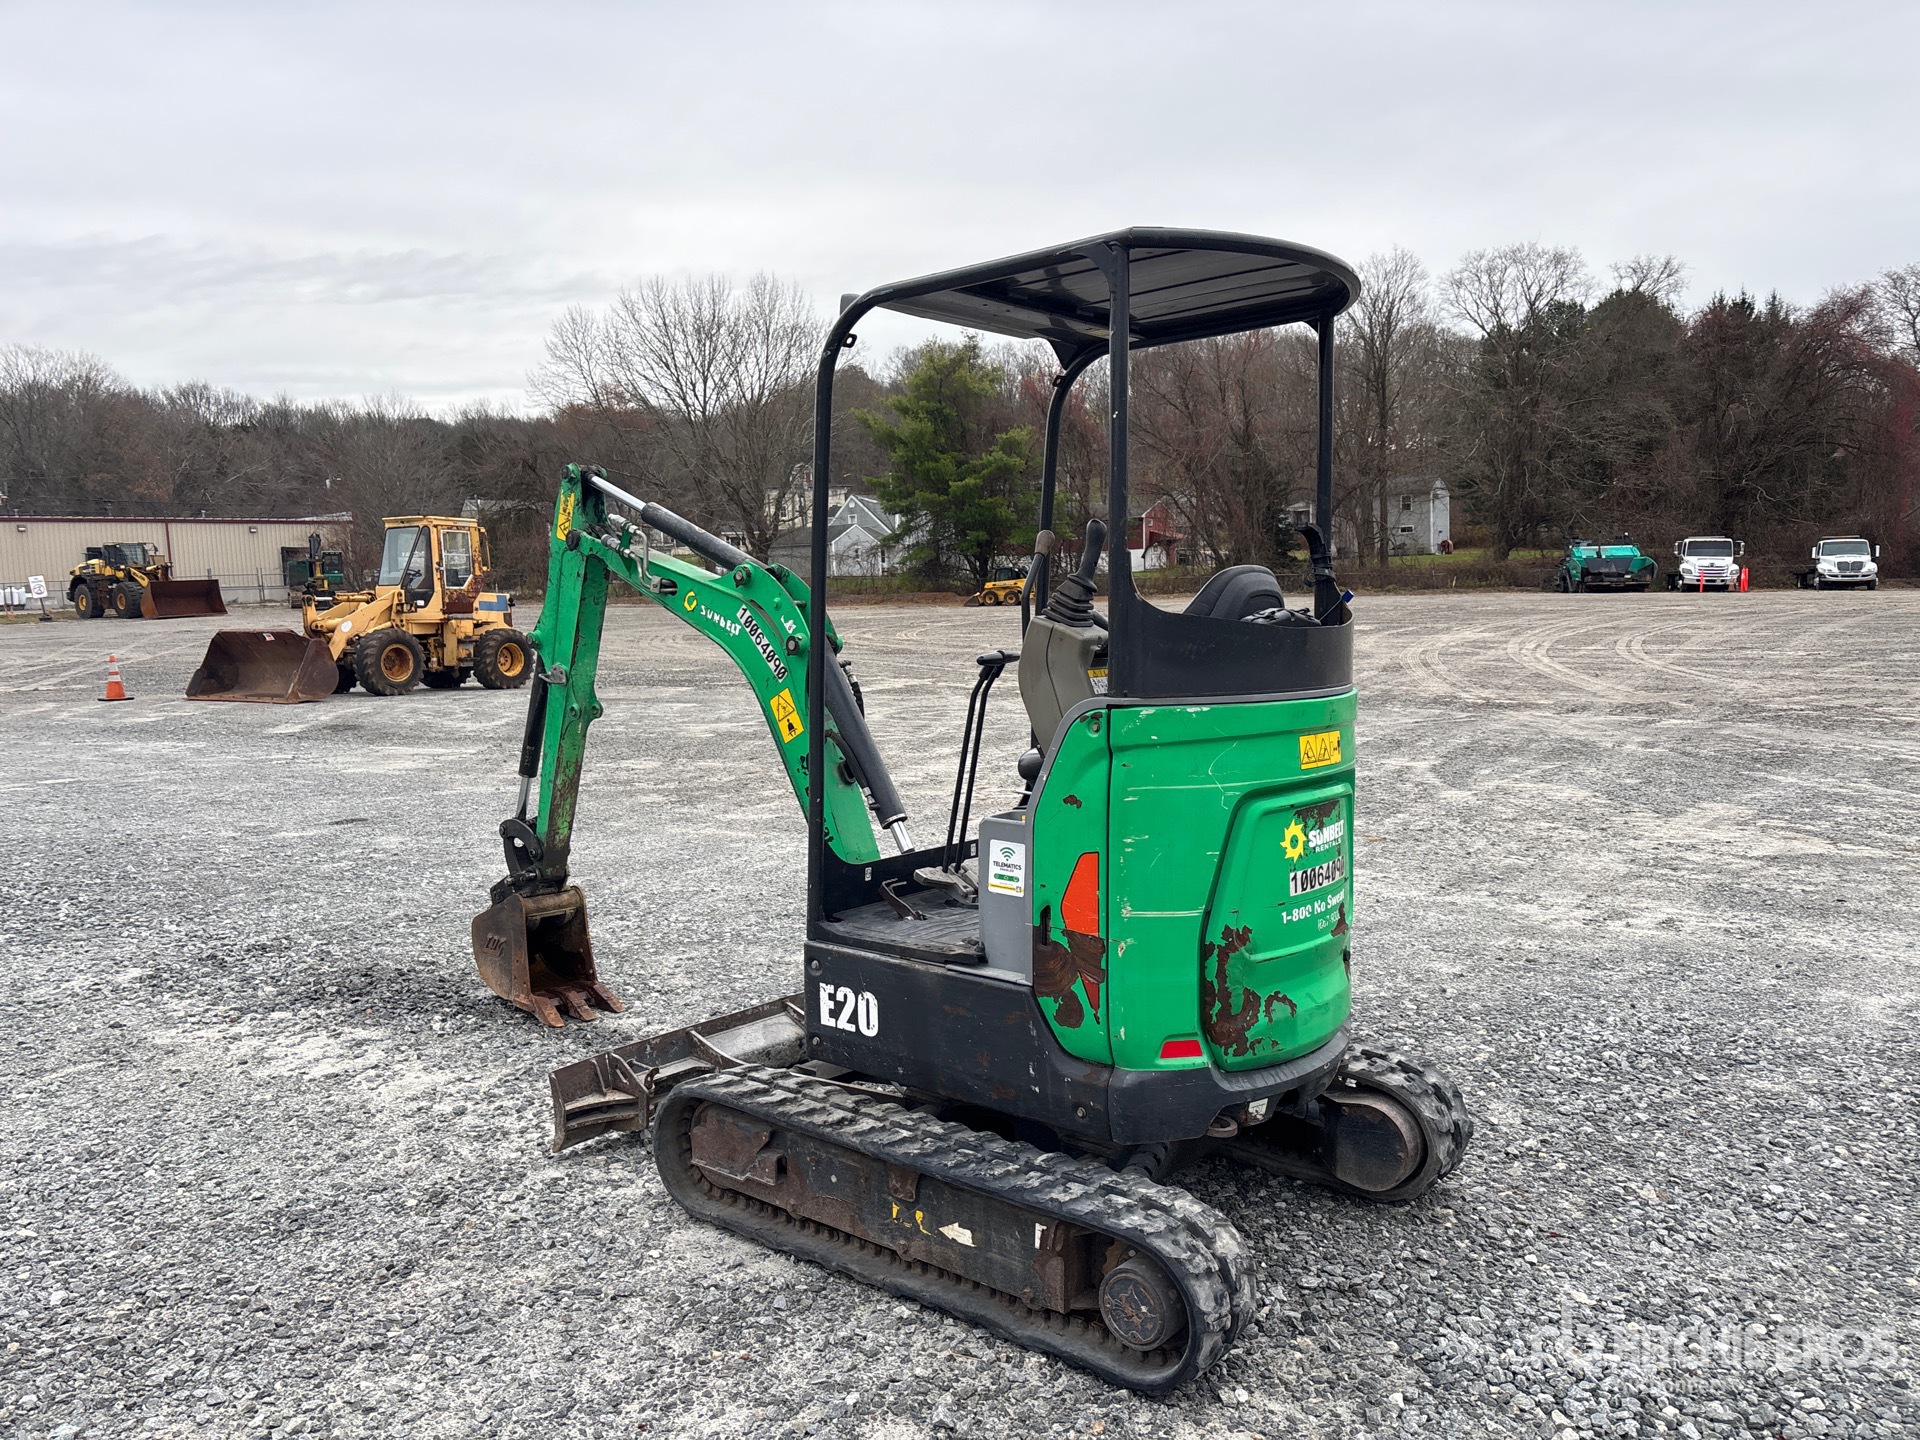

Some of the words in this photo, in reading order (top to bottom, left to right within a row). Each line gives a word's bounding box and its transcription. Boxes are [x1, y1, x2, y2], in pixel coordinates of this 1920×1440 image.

[700, 604, 742, 636] SUNBELT
[739, 606, 788, 680] 10064090
[1308, 819, 1345, 848] SUNBELT
[1315, 837, 1342, 853] RENTALS
[993, 861, 1022, 870] TELEMATICS
[1290, 855, 1345, 894] 10064090
[1281, 904, 1312, 924] 1-800
[1314, 899, 1327, 915] No
[1327, 888, 1345, 909] Sweat
[819, 982, 879, 1037] E20
